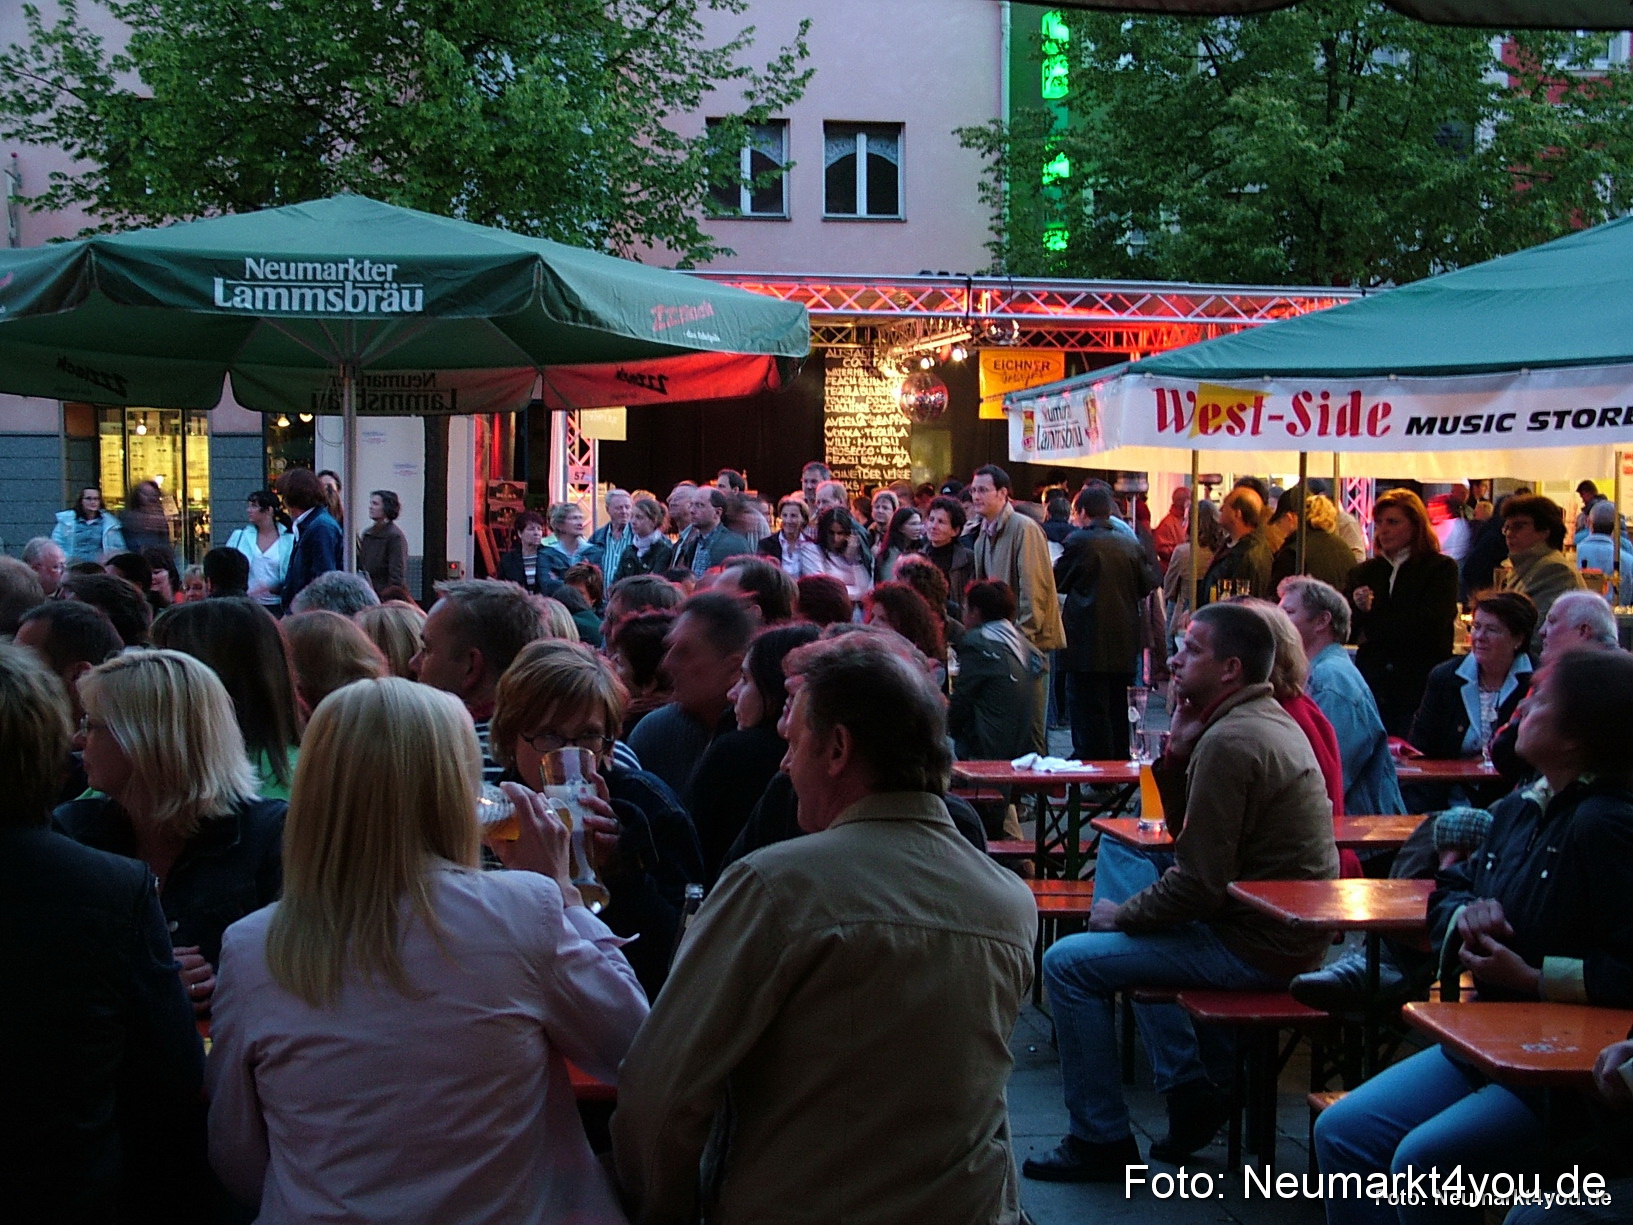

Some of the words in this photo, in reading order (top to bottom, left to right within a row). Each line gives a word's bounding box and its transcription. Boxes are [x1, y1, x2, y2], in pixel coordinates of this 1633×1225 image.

[245, 257, 398, 282] Neumarkter
[213, 277, 424, 313] Lammsbräu
[993, 359, 1051, 372] EICHNER
[1152, 387, 1392, 437] West-Side
[1405, 412, 1517, 437] MUSIC
[574, 471, 586, 481] 57
